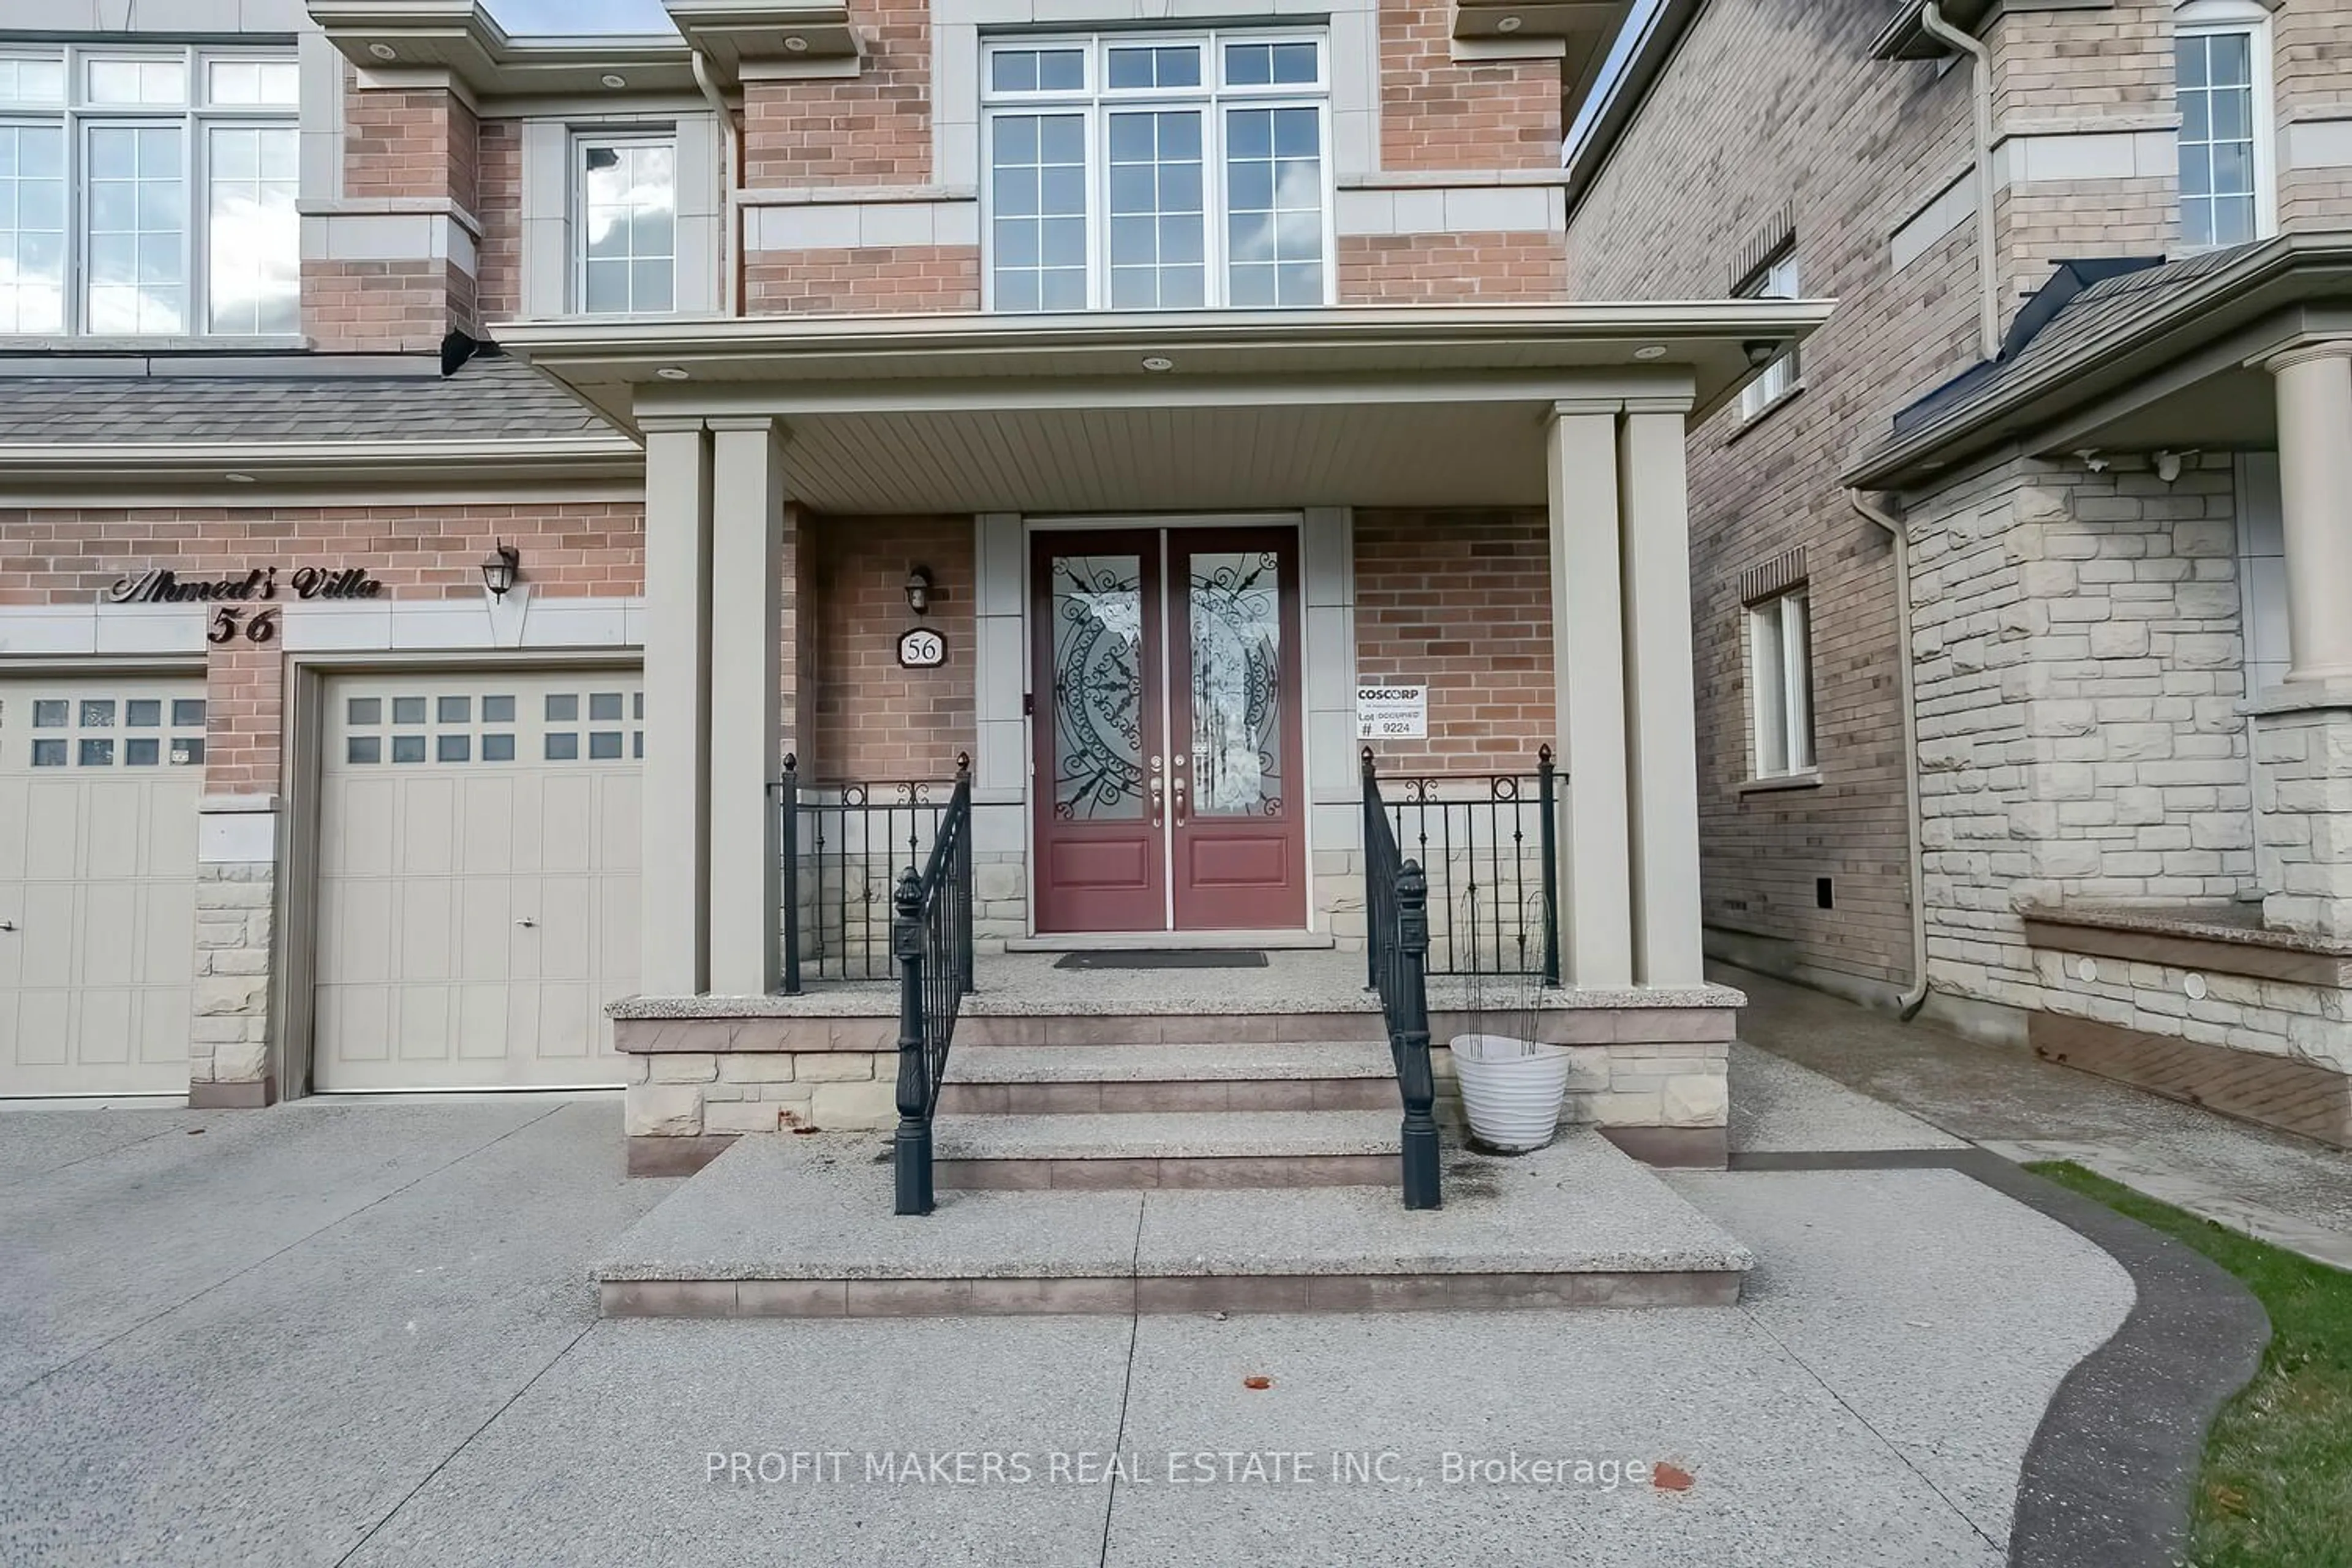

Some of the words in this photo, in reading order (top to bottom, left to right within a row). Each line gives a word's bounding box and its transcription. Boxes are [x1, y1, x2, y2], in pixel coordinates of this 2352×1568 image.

[109, 567, 277, 603] Ahmed's
[291, 567, 382, 600] Villa
[208, 607, 278, 643] 56
[907, 638, 936, 660] 56
[1358, 690, 1419, 699] COSCORP
[1359, 712, 1374, 721] Lot
[1383, 723, 1410, 733] 9224
